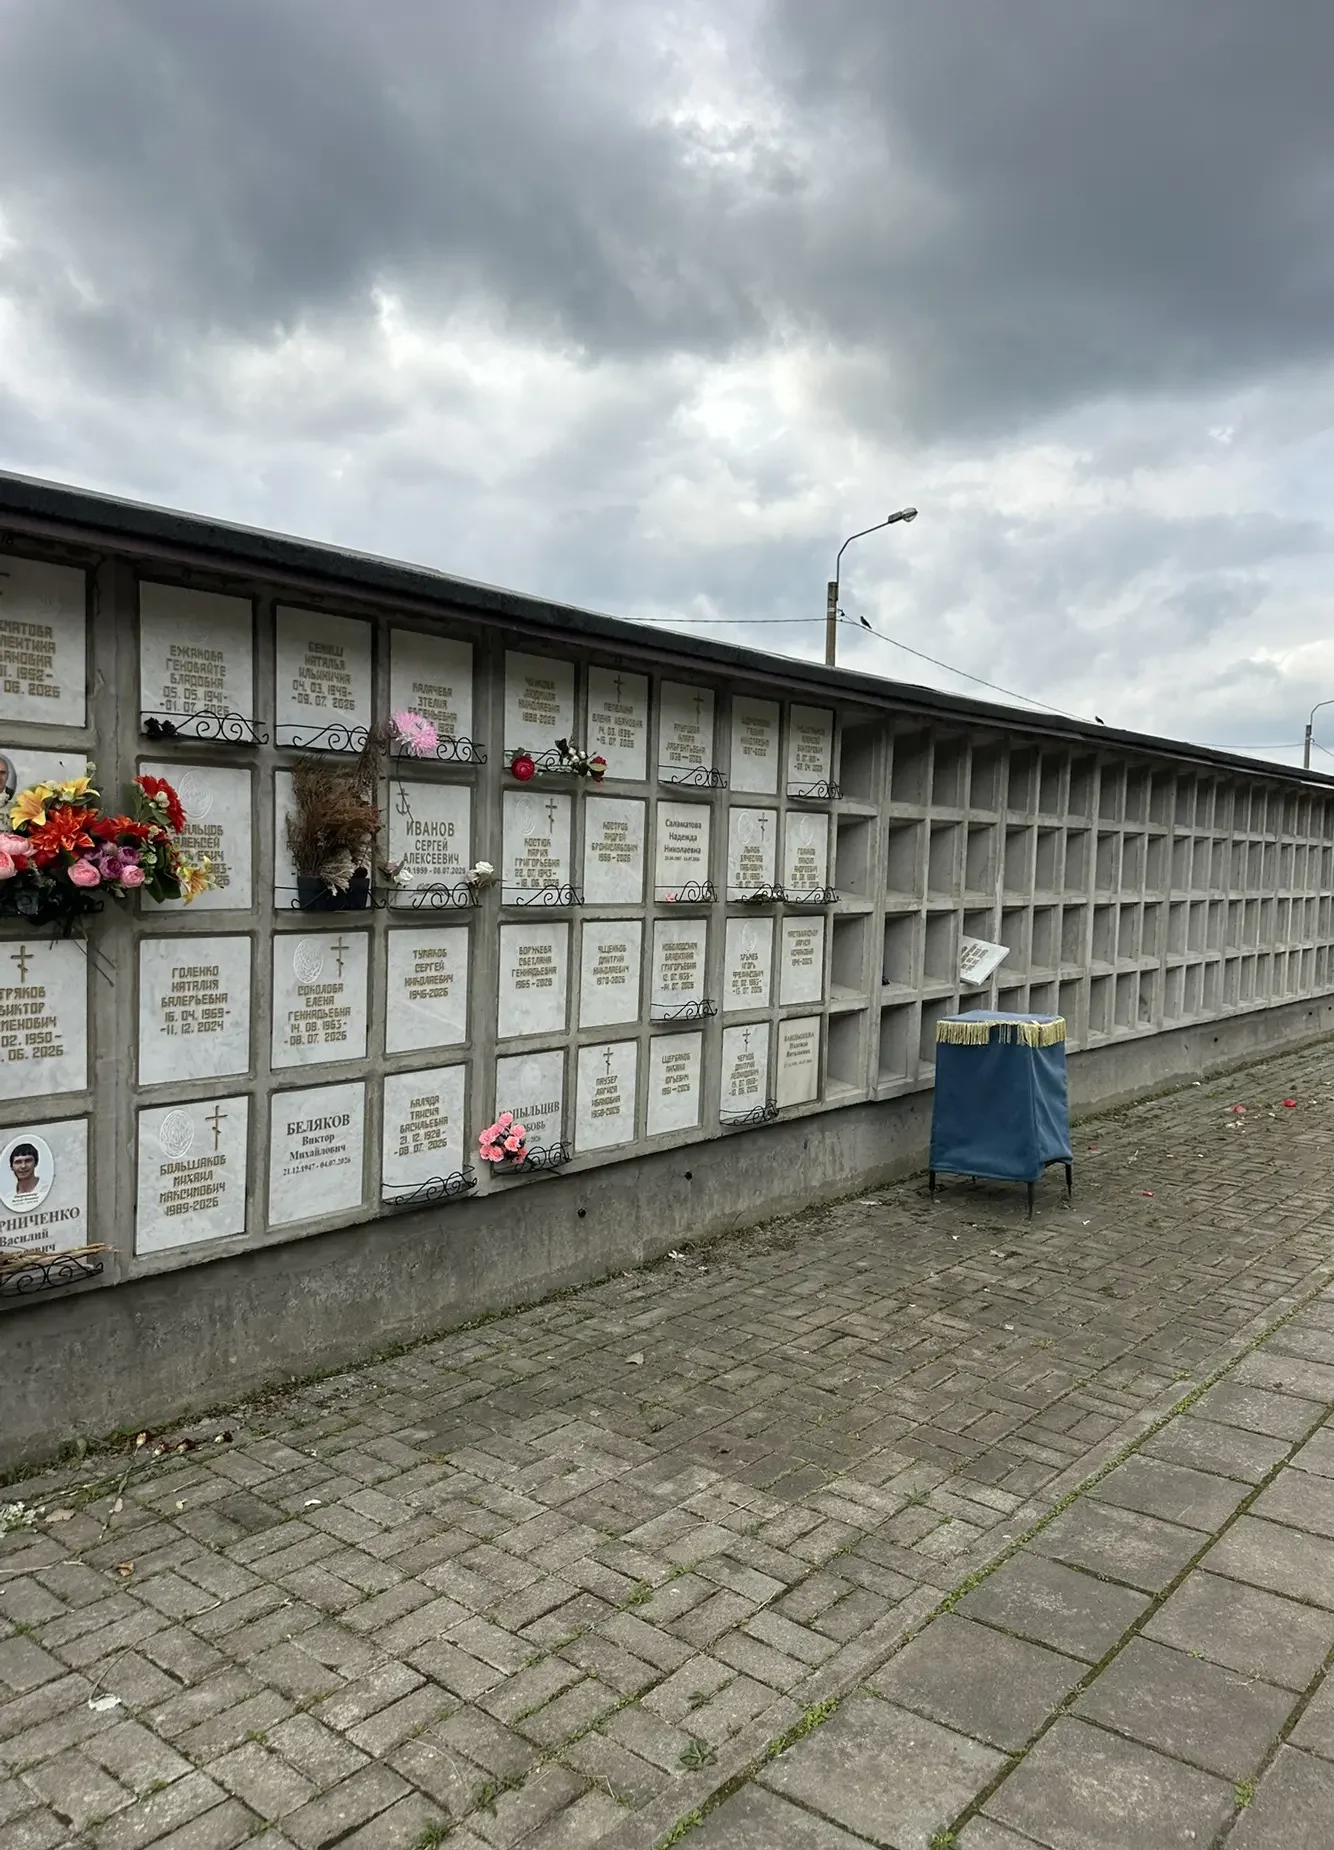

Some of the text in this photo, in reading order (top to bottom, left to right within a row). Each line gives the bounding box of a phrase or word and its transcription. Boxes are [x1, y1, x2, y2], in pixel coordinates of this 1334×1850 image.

[405, 820, 456, 838] ИВАНОВ
[667, 832, 698, 842] Надежда
[414, 837, 449, 853] СЕРГЕЙ
[403, 852, 460, 866] АЛЕКСЕЕВИЧ
[171, 965, 220, 980] ГОЛЕНКО
[415, 960, 444, 973] СЕРГЕЙ
[171, 980, 220, 993] НАТАЛИЯ
[404, 974, 454, 987] НИКОЛАЕВИЧ
[297, 983, 344, 996] СОКОЛОВА
[160, 993, 229, 1009] ВАЛЕРЬЕВНА
[305, 996, 335, 1008] ЕЛЕНА
[287, 1007, 352, 1022] ГЕННАДЬЕВНА
[498, 1100, 560, 1121] ПЫЛЬЦИВ
[286, 1113, 351, 1136] БЕЛЯКОВ
[302, 1133, 336, 1147] Виктор
[289, 1144, 347, 1162] Михайлович
[160, 1154, 227, 1177] БОЛЬШАКОВ
[173, 1170, 214, 1189] МИХАИЛ
[159, 1181, 227, 1204] МАКСИМОВИЧ
[0, 1227, 49, 1246] Василий
